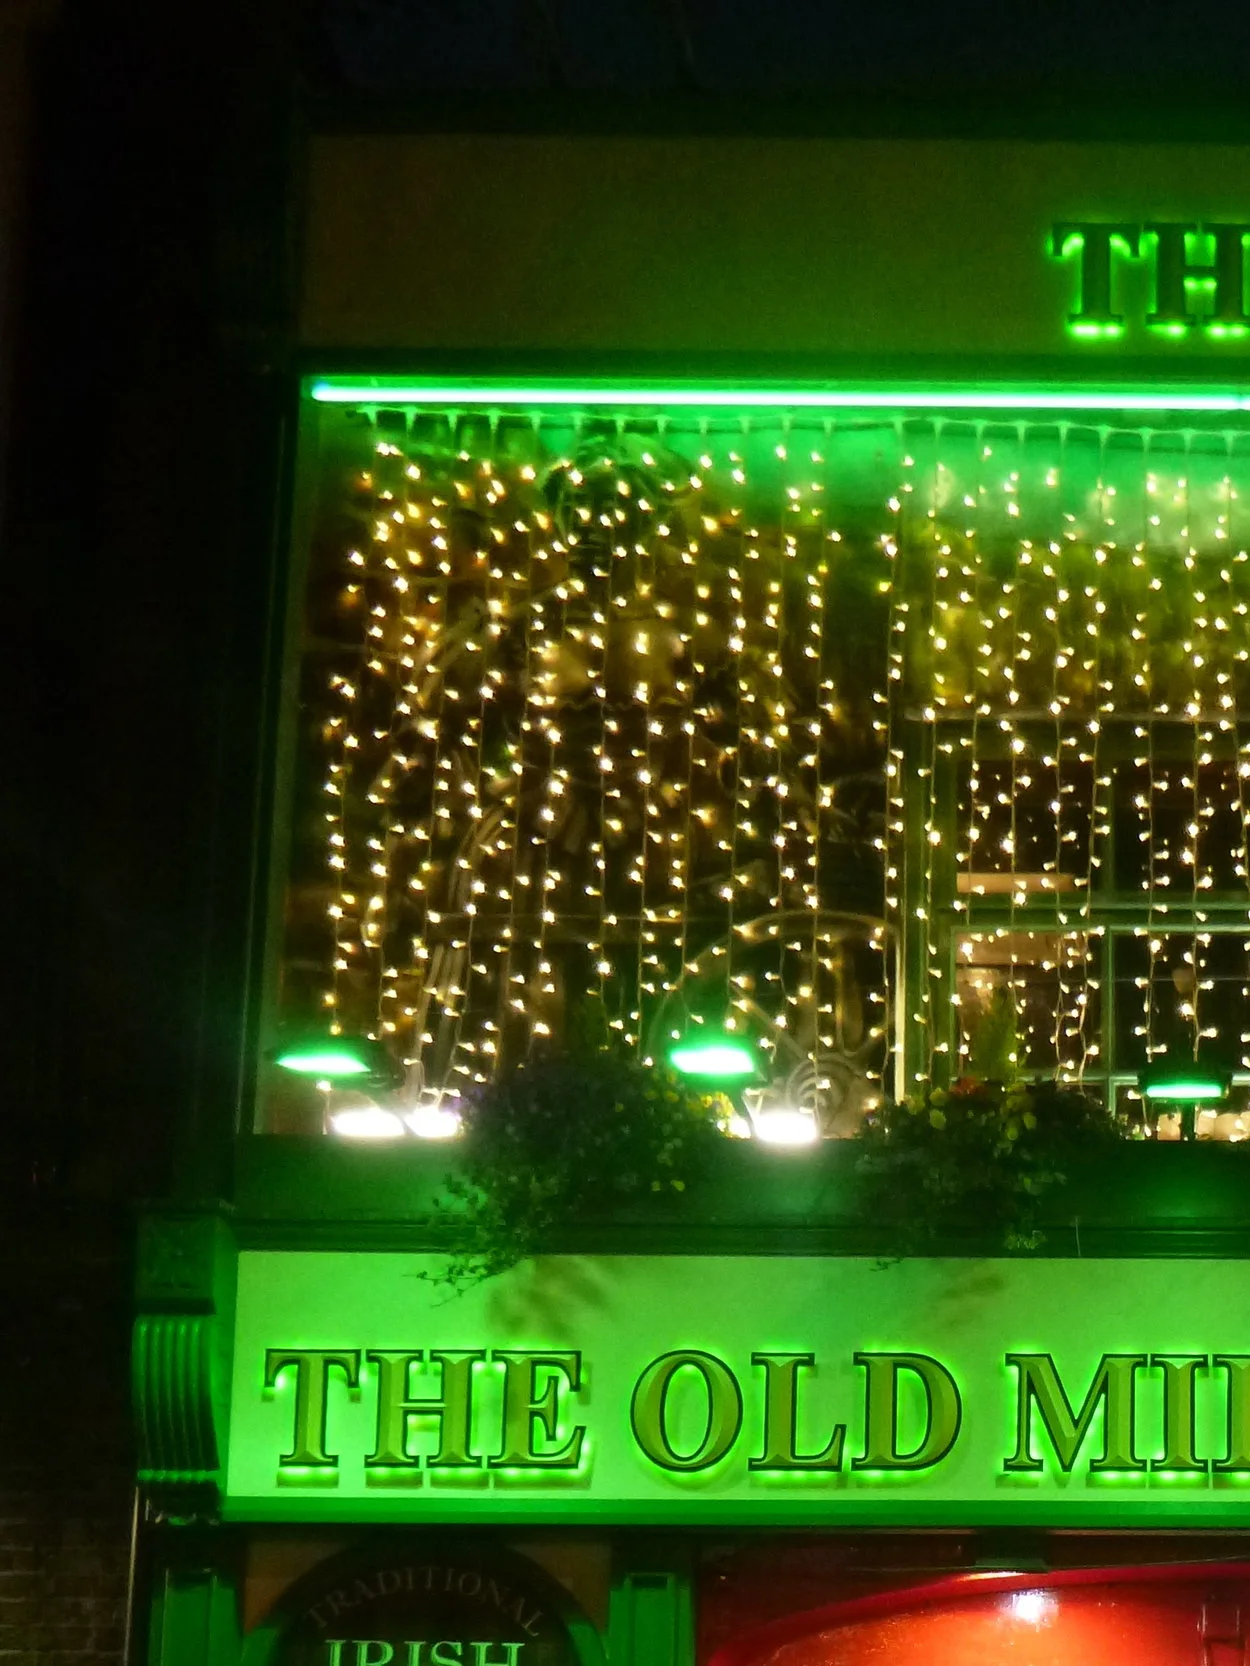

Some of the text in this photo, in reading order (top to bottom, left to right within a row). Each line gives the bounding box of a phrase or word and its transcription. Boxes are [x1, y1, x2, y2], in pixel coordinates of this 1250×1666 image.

[263, 1348, 584, 1472] THE
[630, 1350, 962, 1474] OLD
[303, 1565, 545, 1638] TRADITIONAL
